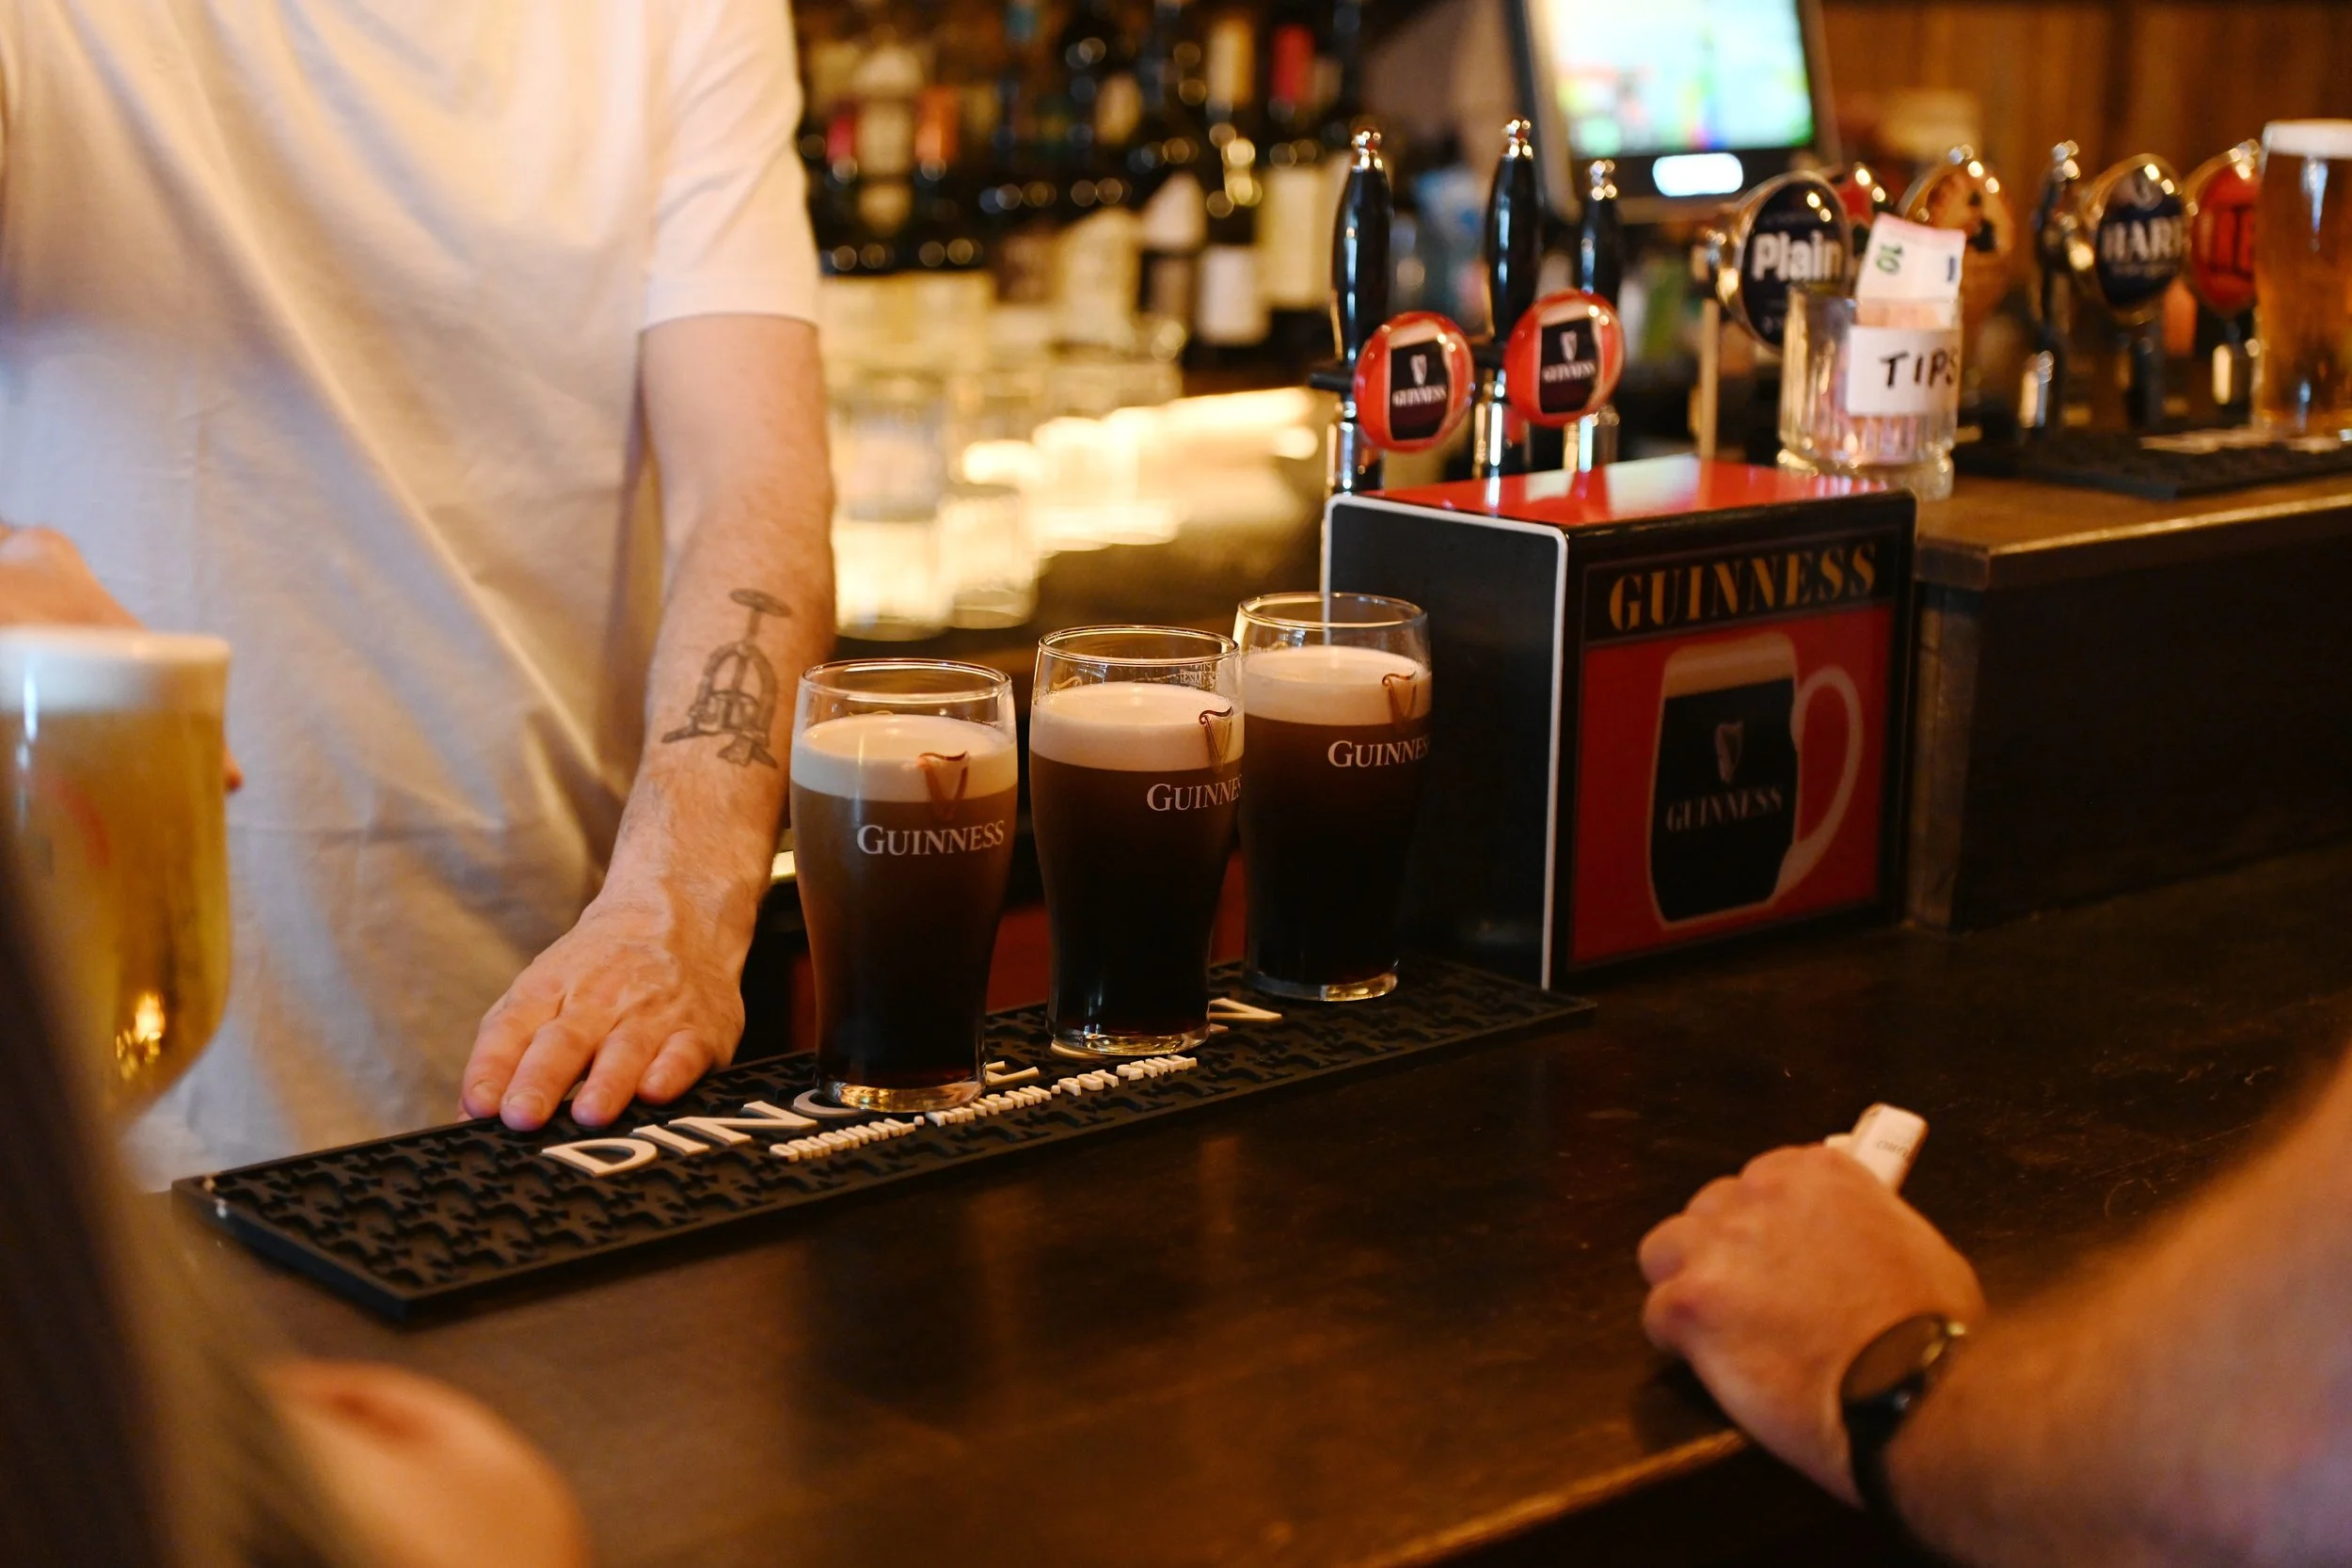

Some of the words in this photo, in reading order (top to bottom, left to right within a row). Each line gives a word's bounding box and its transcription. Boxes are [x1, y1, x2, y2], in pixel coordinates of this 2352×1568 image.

[1752, 230, 1843, 280] Plain
[1542, 359, 1597, 383] GUINNESS
[1392, 384, 1447, 407] GUINNESS
[1609, 542, 1876, 631] GUINNESS
[1665, 785, 1784, 833] GUINNESS
[857, 820, 1005, 856] GUINNESS
[1057, 1069, 1120, 1097] POT
